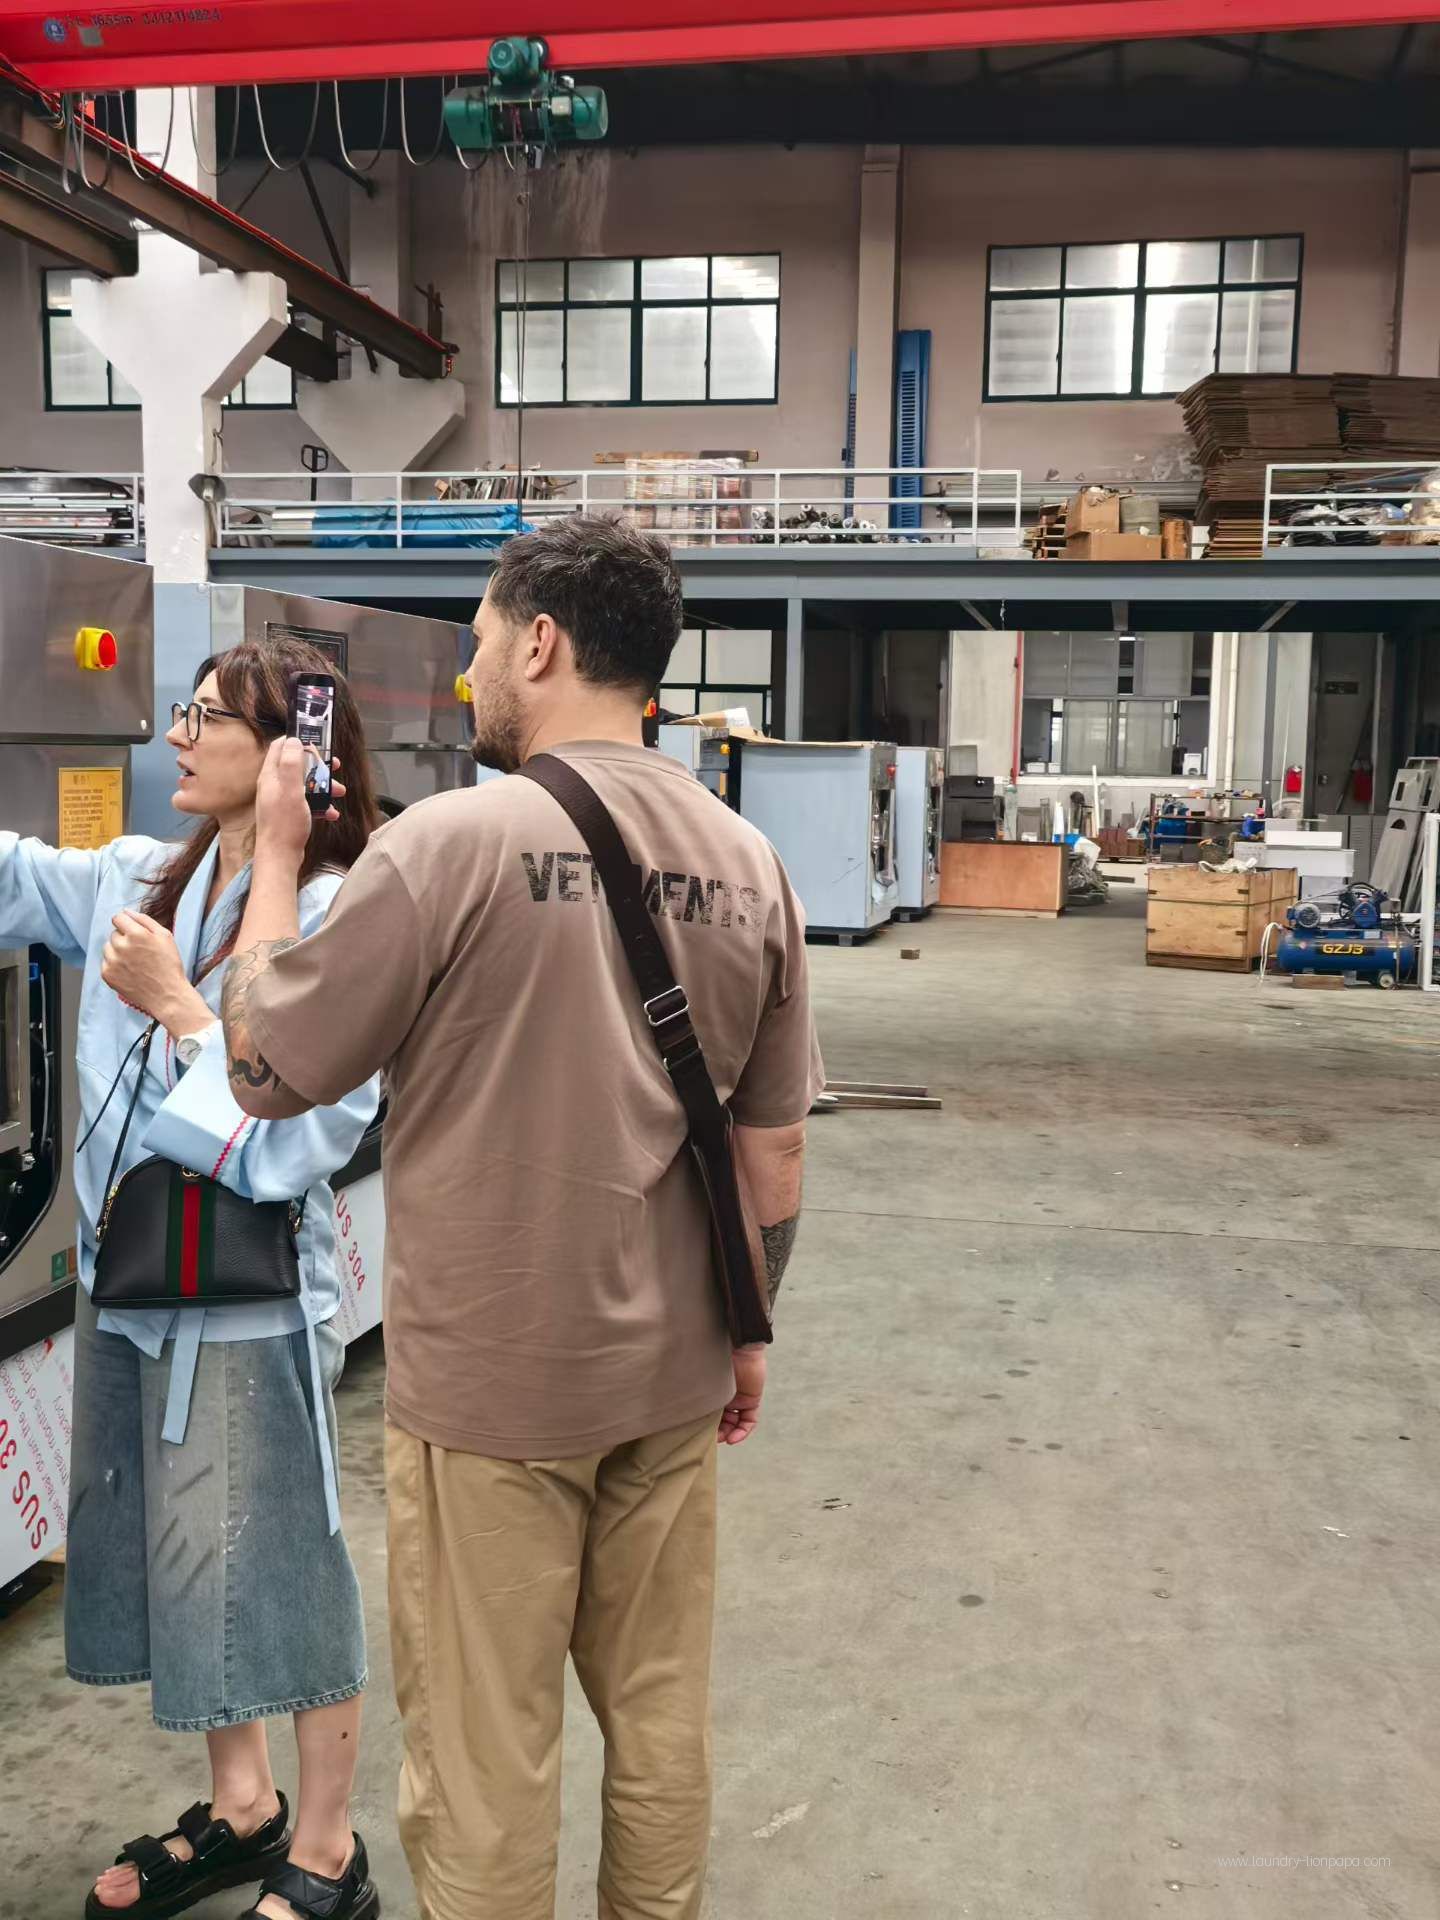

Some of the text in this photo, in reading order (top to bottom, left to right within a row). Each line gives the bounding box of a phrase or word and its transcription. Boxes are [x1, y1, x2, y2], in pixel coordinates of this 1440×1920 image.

[334, 1192, 352, 1238] US
[348, 1241, 366, 1292] 304
[12, 1469, 49, 1551] SUS
